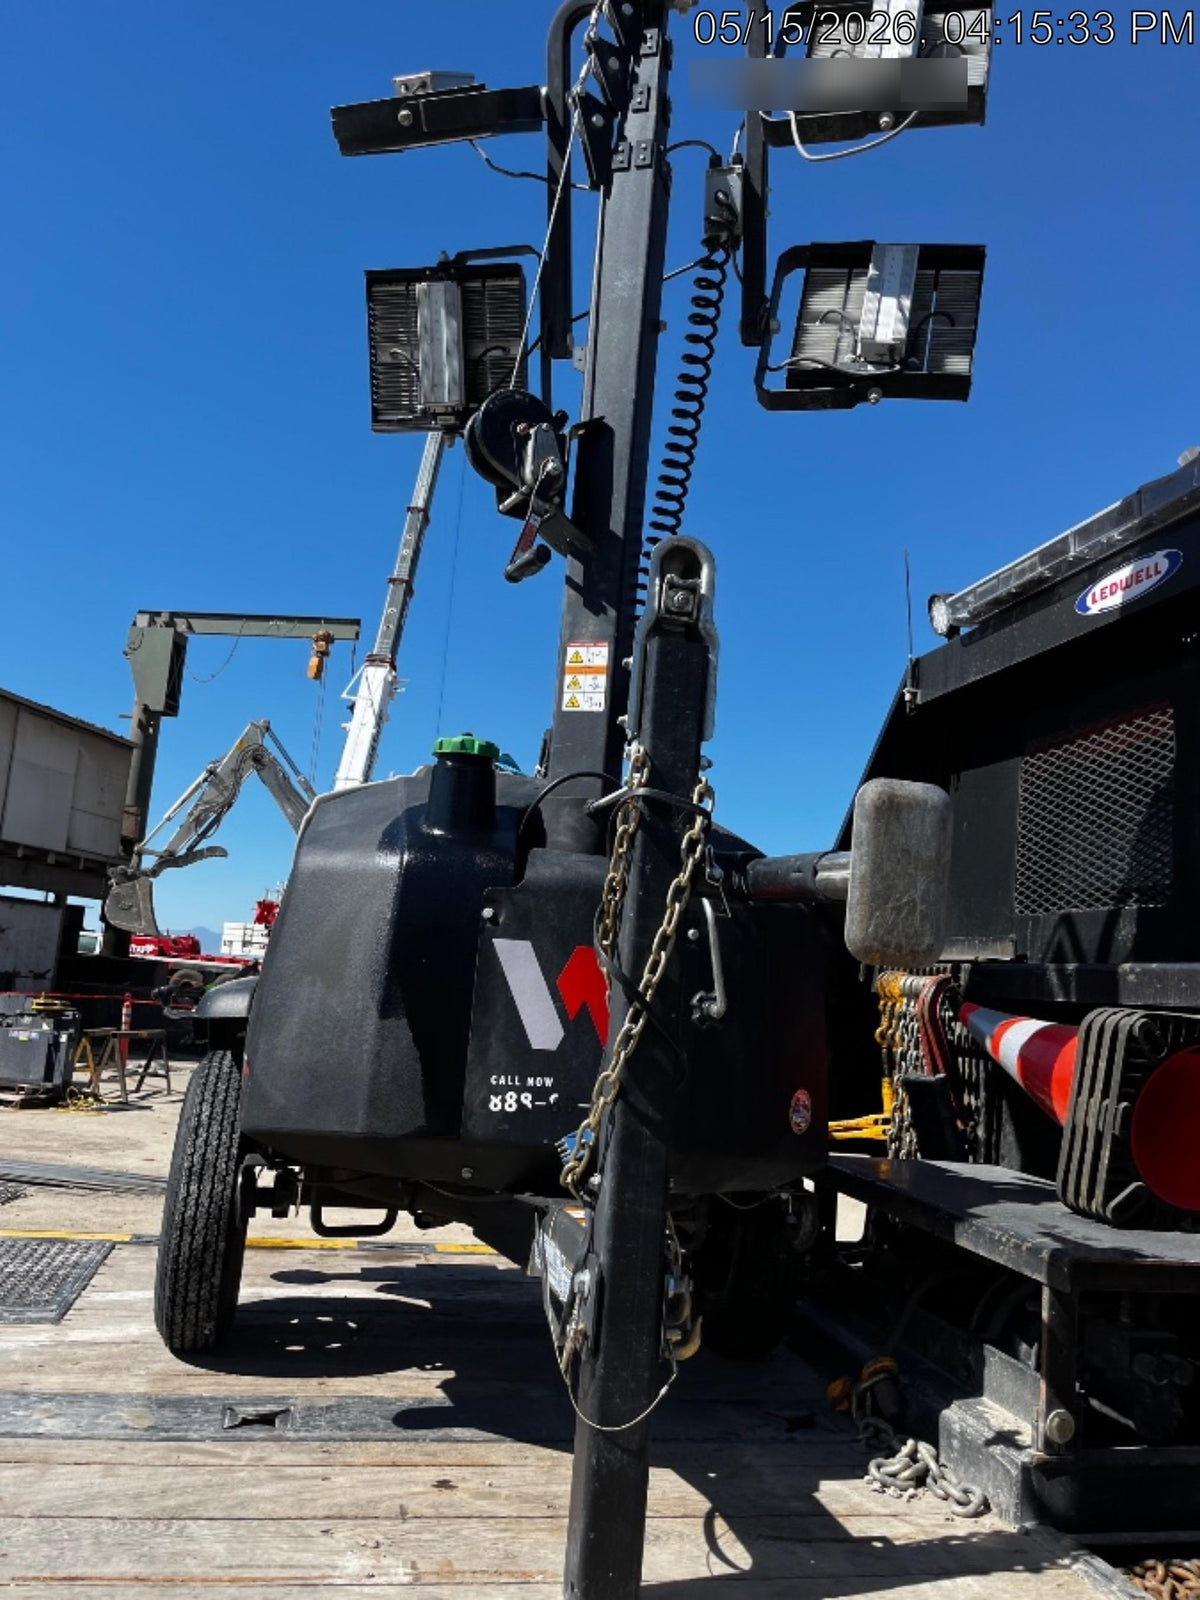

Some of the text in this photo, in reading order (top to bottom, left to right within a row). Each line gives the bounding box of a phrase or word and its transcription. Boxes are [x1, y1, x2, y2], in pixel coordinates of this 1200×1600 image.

[1091, 561, 1163, 605] LEDWELL
[490, 1075, 554, 1088] CALL NOW
